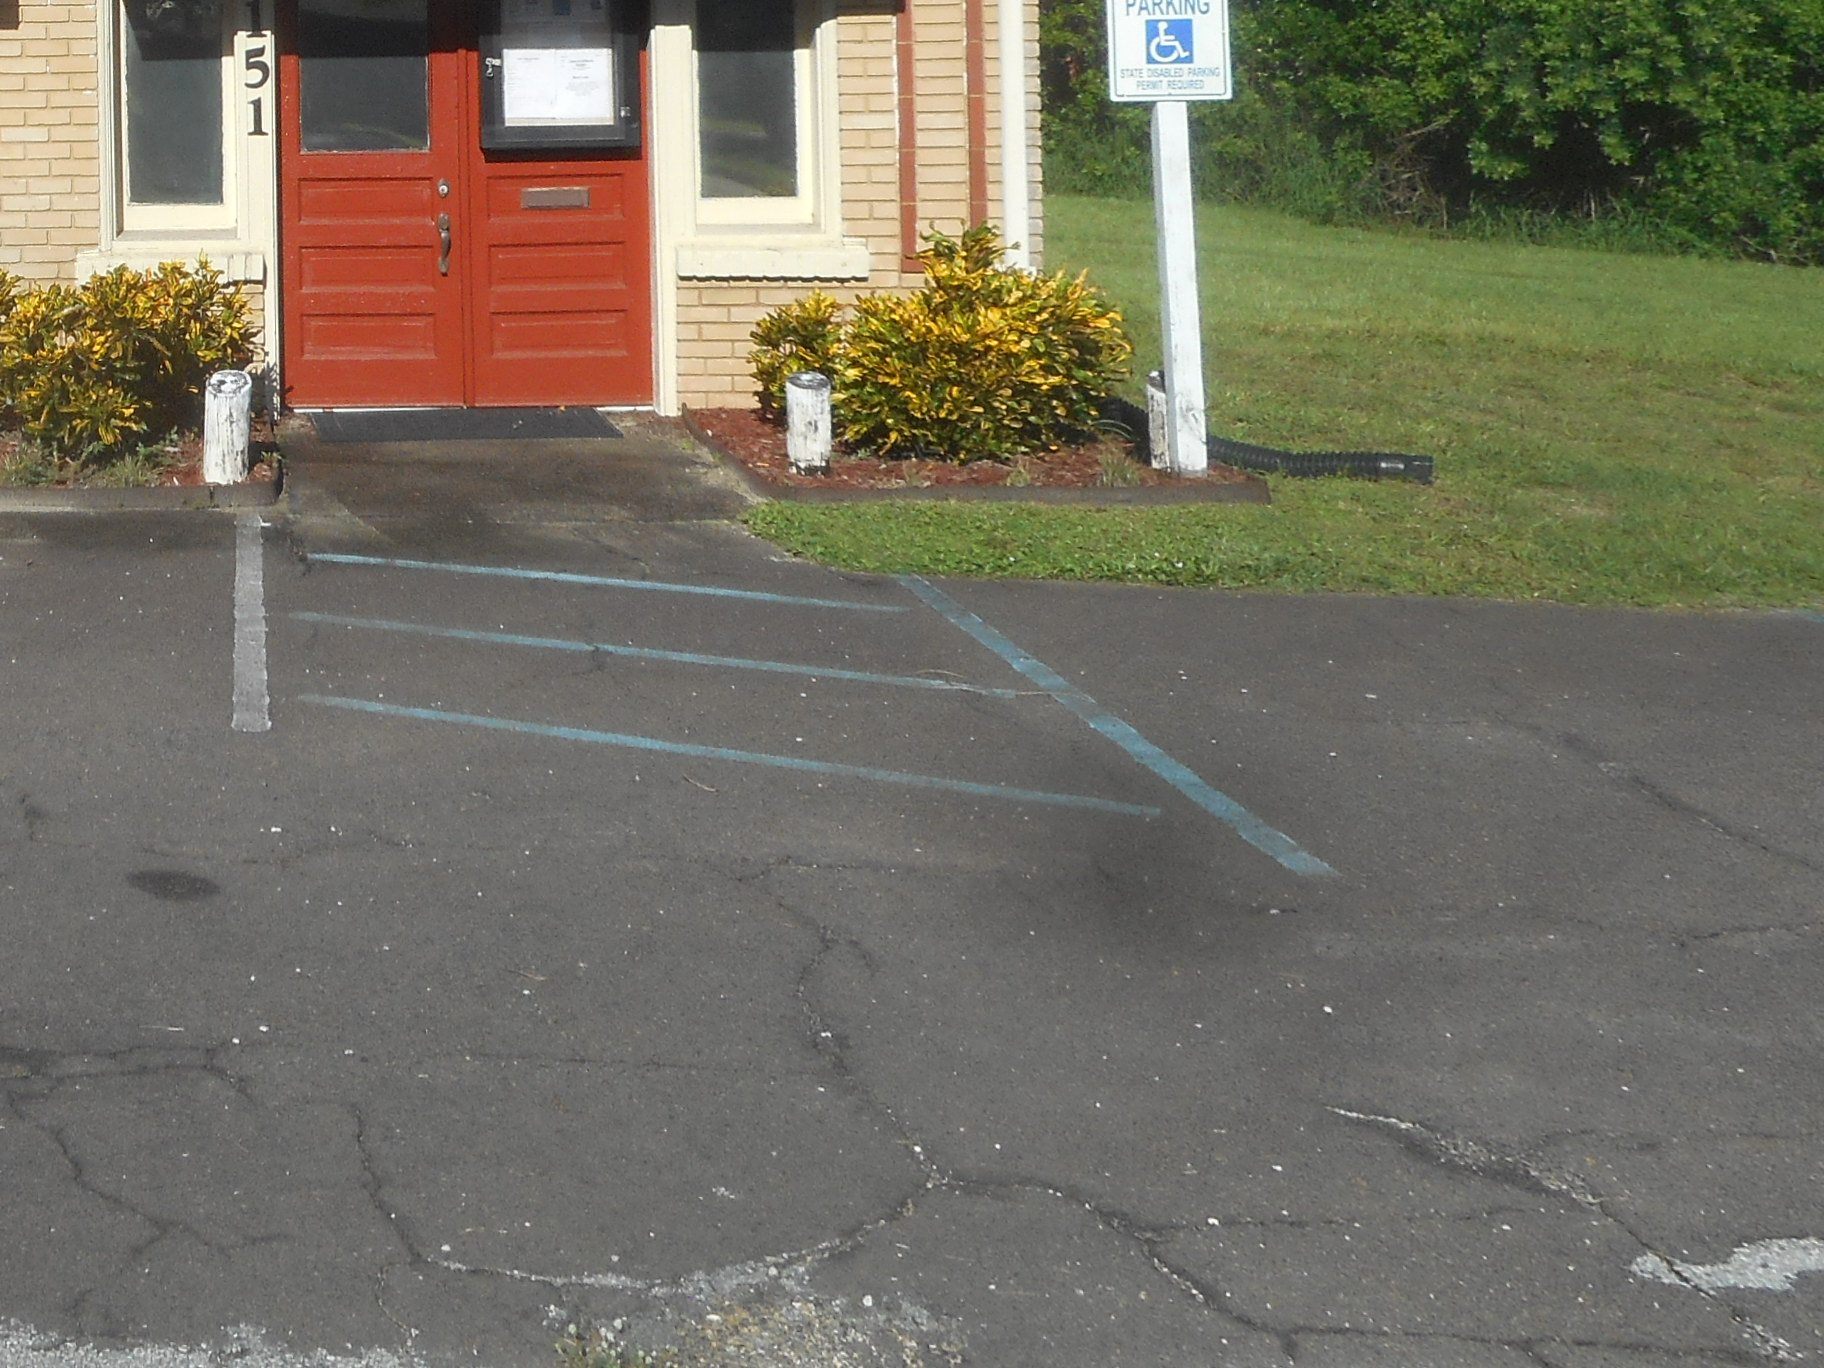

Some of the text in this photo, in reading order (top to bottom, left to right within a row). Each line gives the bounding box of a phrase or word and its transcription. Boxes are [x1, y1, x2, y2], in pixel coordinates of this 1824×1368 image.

[1120, 66, 1220, 79] STATE DISABLED PARKING
[1136, 78, 1205, 90] PERMIT REQUIRED
